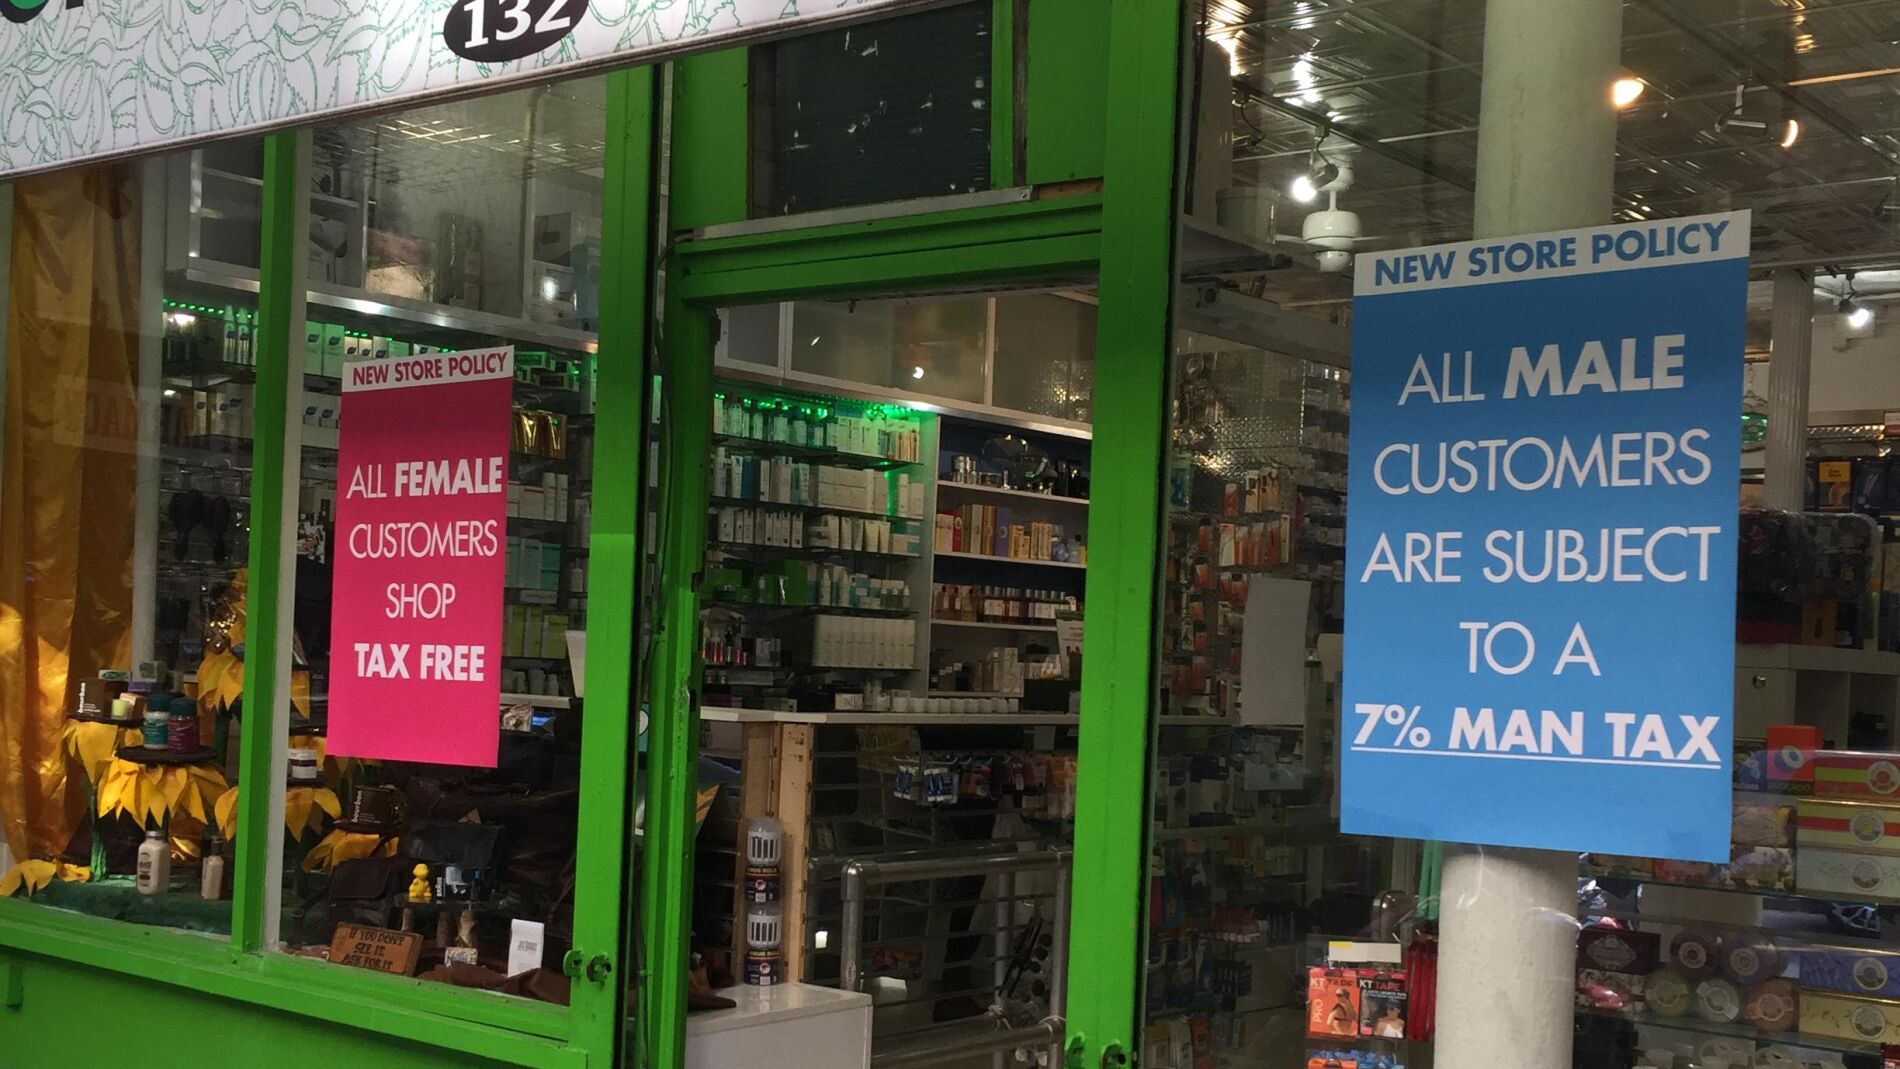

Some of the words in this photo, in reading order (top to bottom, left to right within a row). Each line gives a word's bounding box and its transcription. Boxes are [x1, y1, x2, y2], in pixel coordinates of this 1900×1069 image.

[463, 0, 571, 49] 132
[1375, 250, 1456, 287] NEW
[1467, 237, 1577, 277] STORE
[1592, 220, 1730, 265] POLICY
[353, 364, 389, 386] NEW
[395, 359, 442, 383] STORE
[449, 352, 508, 377] POLICY
[1397, 350, 1485, 406] ALL
[1502, 333, 1685, 400] MALE
[346, 464, 387, 499] ALL
[395, 456, 503, 497] FEMALE
[1374, 428, 1712, 496] CUSTOMERS
[349, 519, 498, 559] CUSTOMERS
[1360, 531, 1463, 583] ARE
[1482, 526, 1721, 584] SUBJECT
[385, 582, 456, 619] SHOP
[354, 643, 410, 679] TAX
[420, 644, 485, 682] FREE
[1459, 621, 1536, 675] TO
[1552, 622, 1602, 676] A
[1354, 703, 1431, 748] 7%
[1448, 707, 1584, 755] MAN
[1604, 712, 1721, 762] TAX
[350, 790, 363, 823] bourbon
[348, 927, 357, 939] IF
[359, 930, 377, 941] YOU
[353, 942, 372, 955] SEE
[374, 945, 385, 956] IT
[363, 957, 382, 968] FOR
[383, 960, 393, 970] IT
[1310, 977, 1326, 987] KT
[1360, 979, 1373, 989] KT
[1375, 981, 1400, 991] TAPE
[1313, 998, 1324, 1023] PRO
